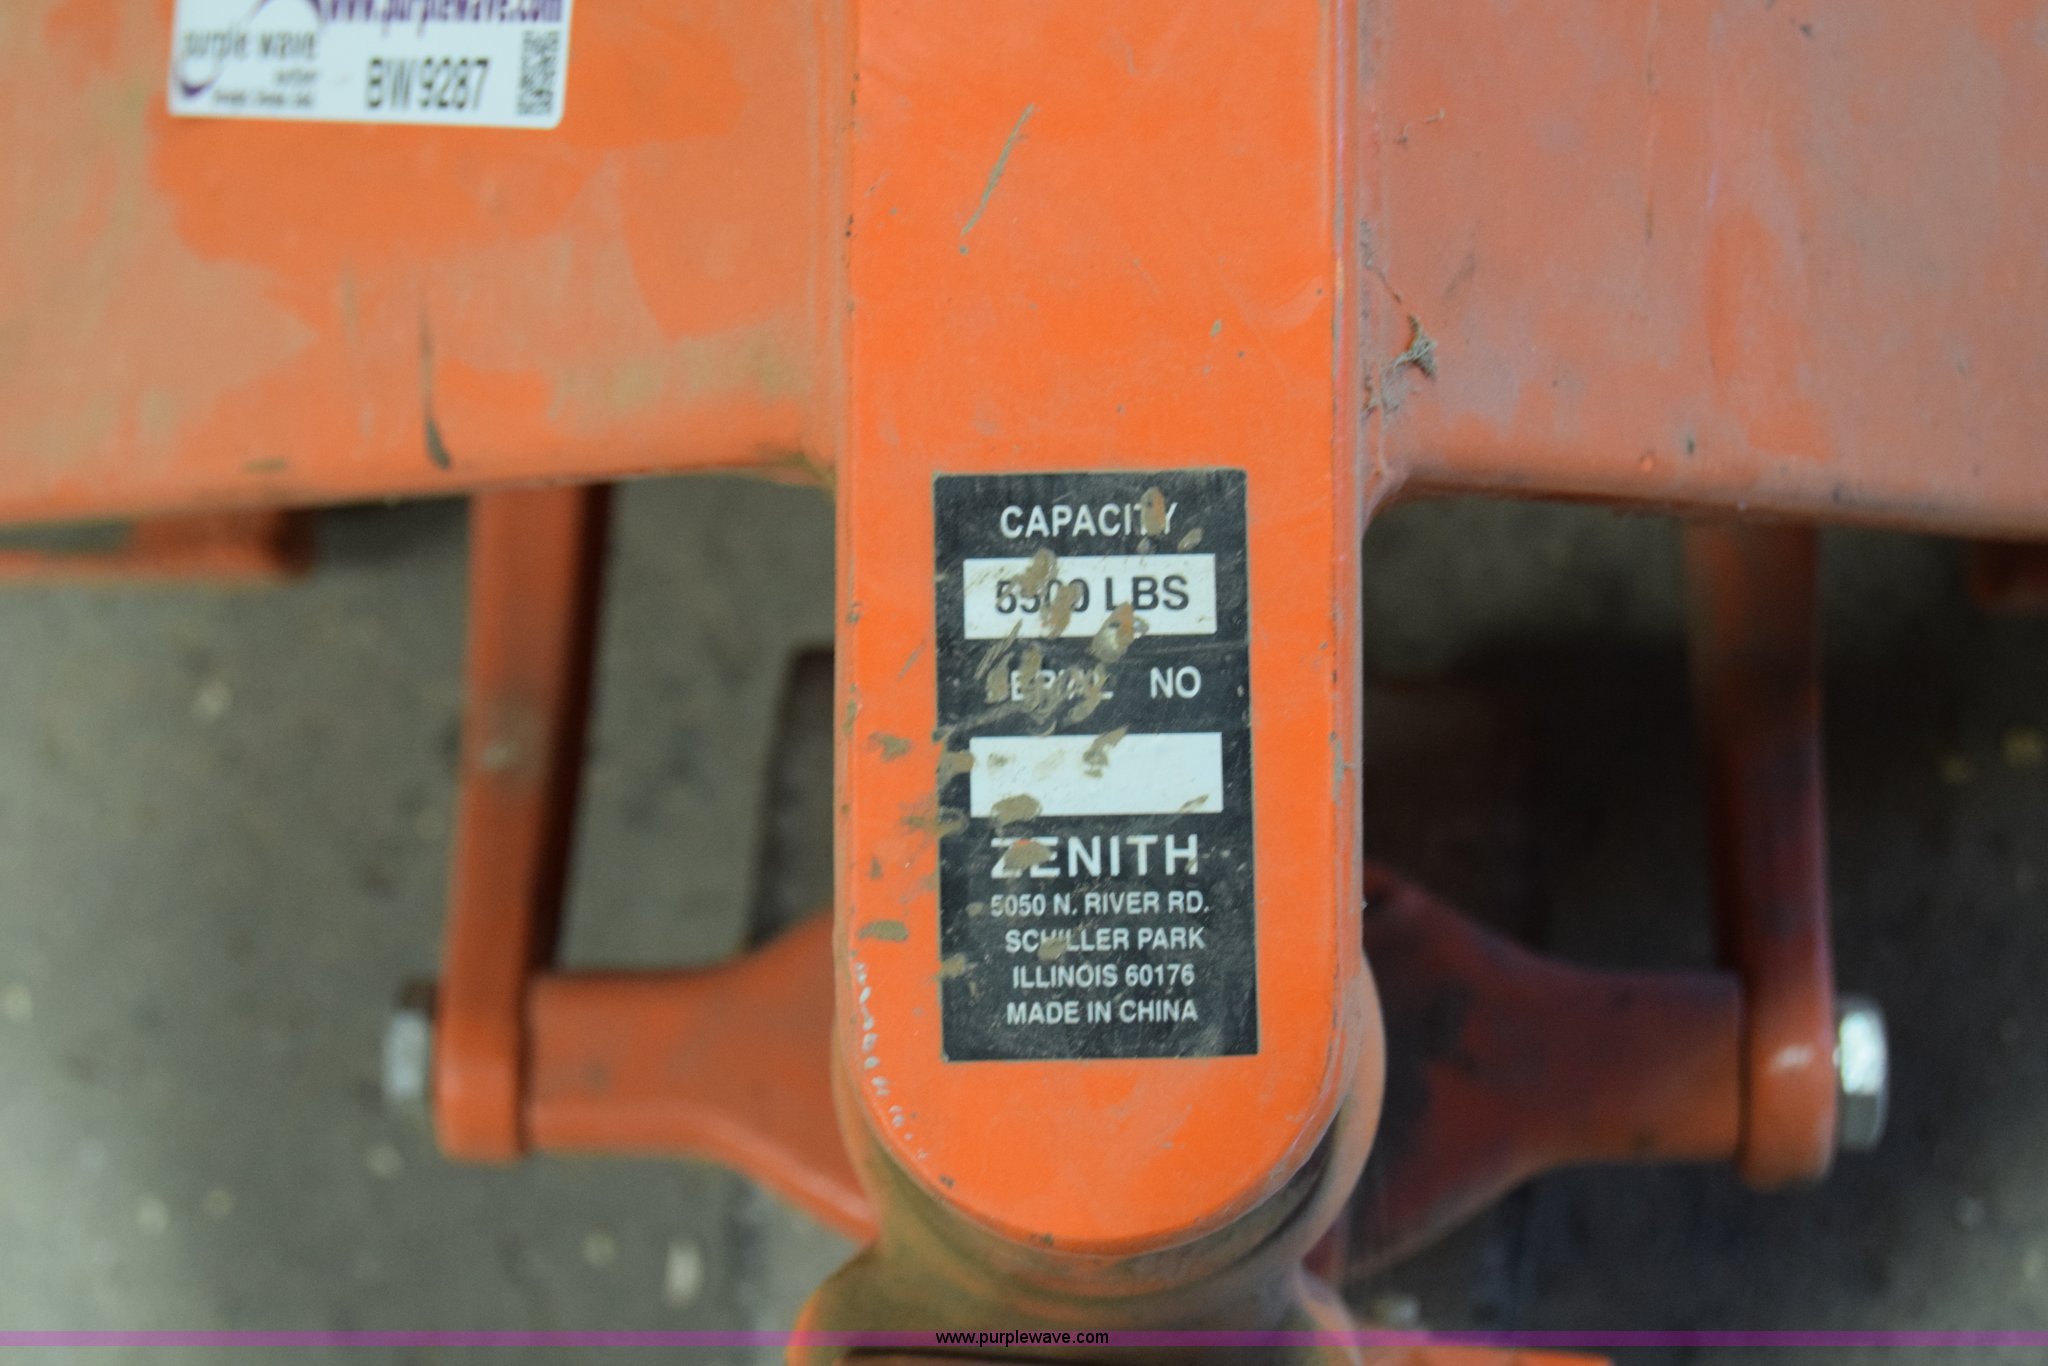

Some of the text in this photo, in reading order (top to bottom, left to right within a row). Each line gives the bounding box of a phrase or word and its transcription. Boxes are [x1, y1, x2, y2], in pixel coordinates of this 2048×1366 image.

[365, 56, 490, 111] BW9287
[1105, 574, 1191, 611] LBS
[1150, 664, 1202, 699] NO
[990, 833, 1200, 879] ZENITH
[990, 890, 1210, 918] 5050 N. RIVER RD.
[1137, 927, 1206, 951] PARK
[1012, 963, 1196, 989] ILLINOIS 60176
[1006, 999, 1199, 1025] MADE IN CHINA
